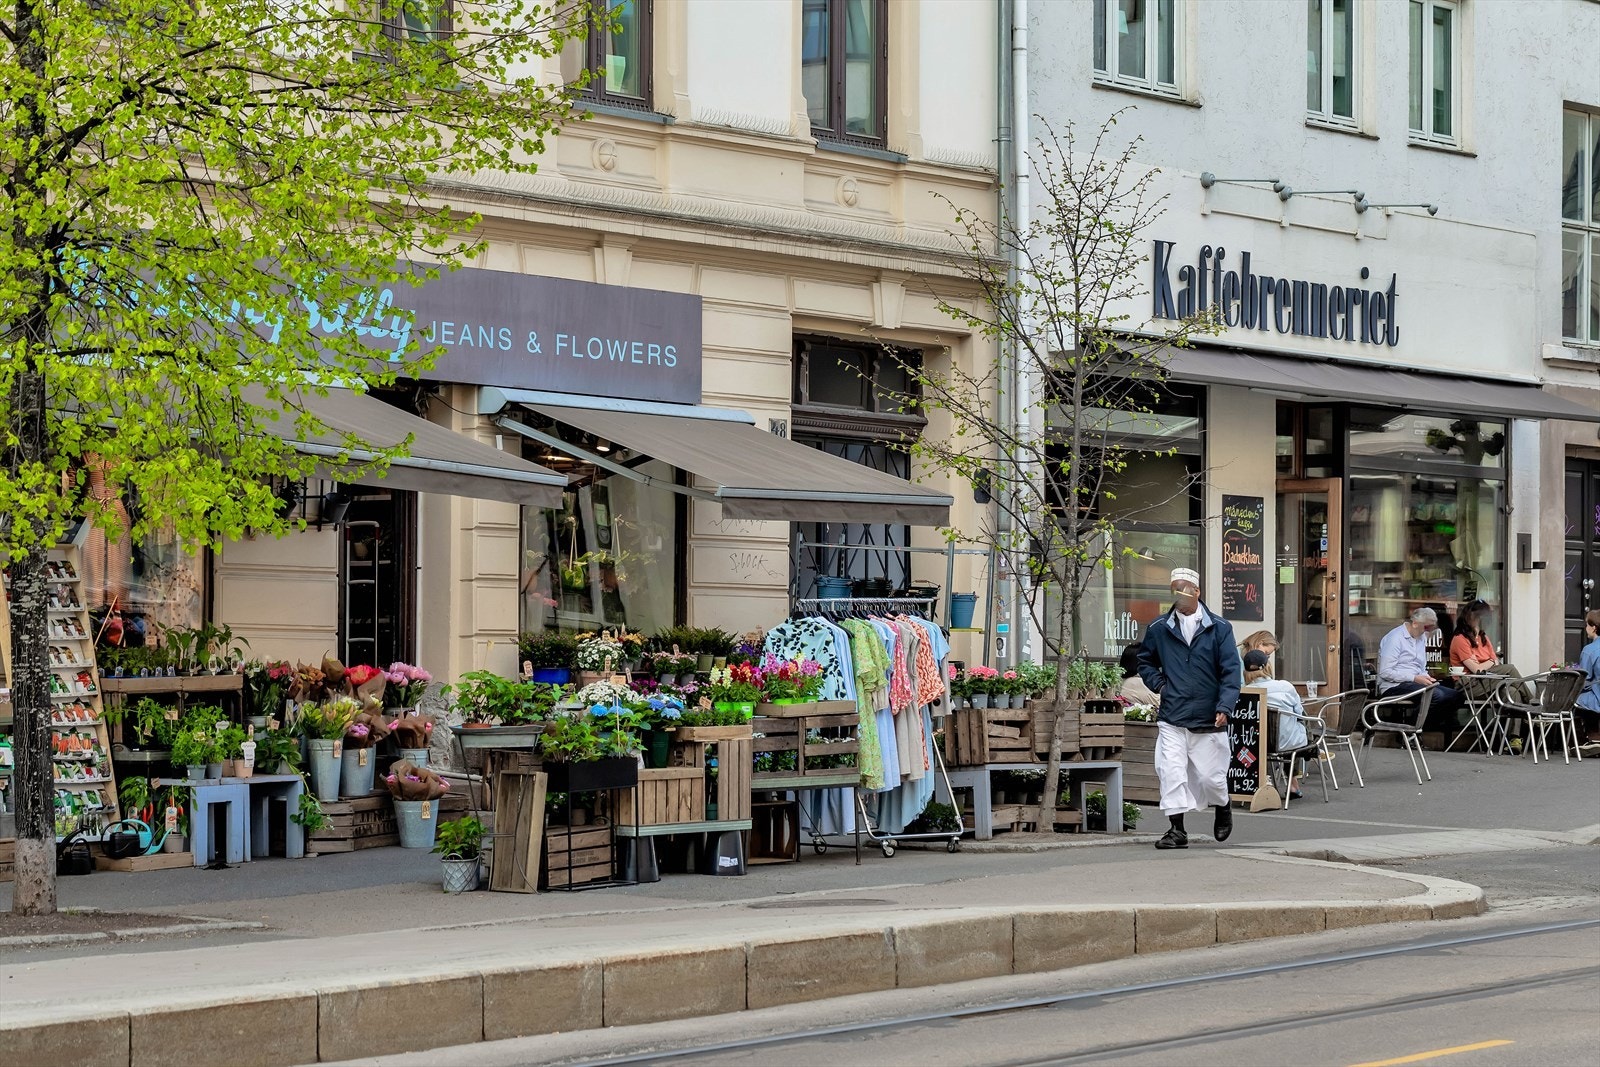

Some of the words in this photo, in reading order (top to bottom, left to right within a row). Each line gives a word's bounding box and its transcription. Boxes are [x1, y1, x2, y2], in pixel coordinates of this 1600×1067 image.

[1153, 239, 1399, 347] Kaffebrenneriet
[425, 320, 512, 351] JEANS
[527, 331, 542, 354] &
[556, 333, 678, 368] FLOWERS
[771, 421, 786, 439] 48
[1104, 611, 1138, 640] Kaffe
[1231, 701, 1260, 723] usk!
[1240, 724, 1257, 746] til
[1228, 763, 1248, 778] mai
